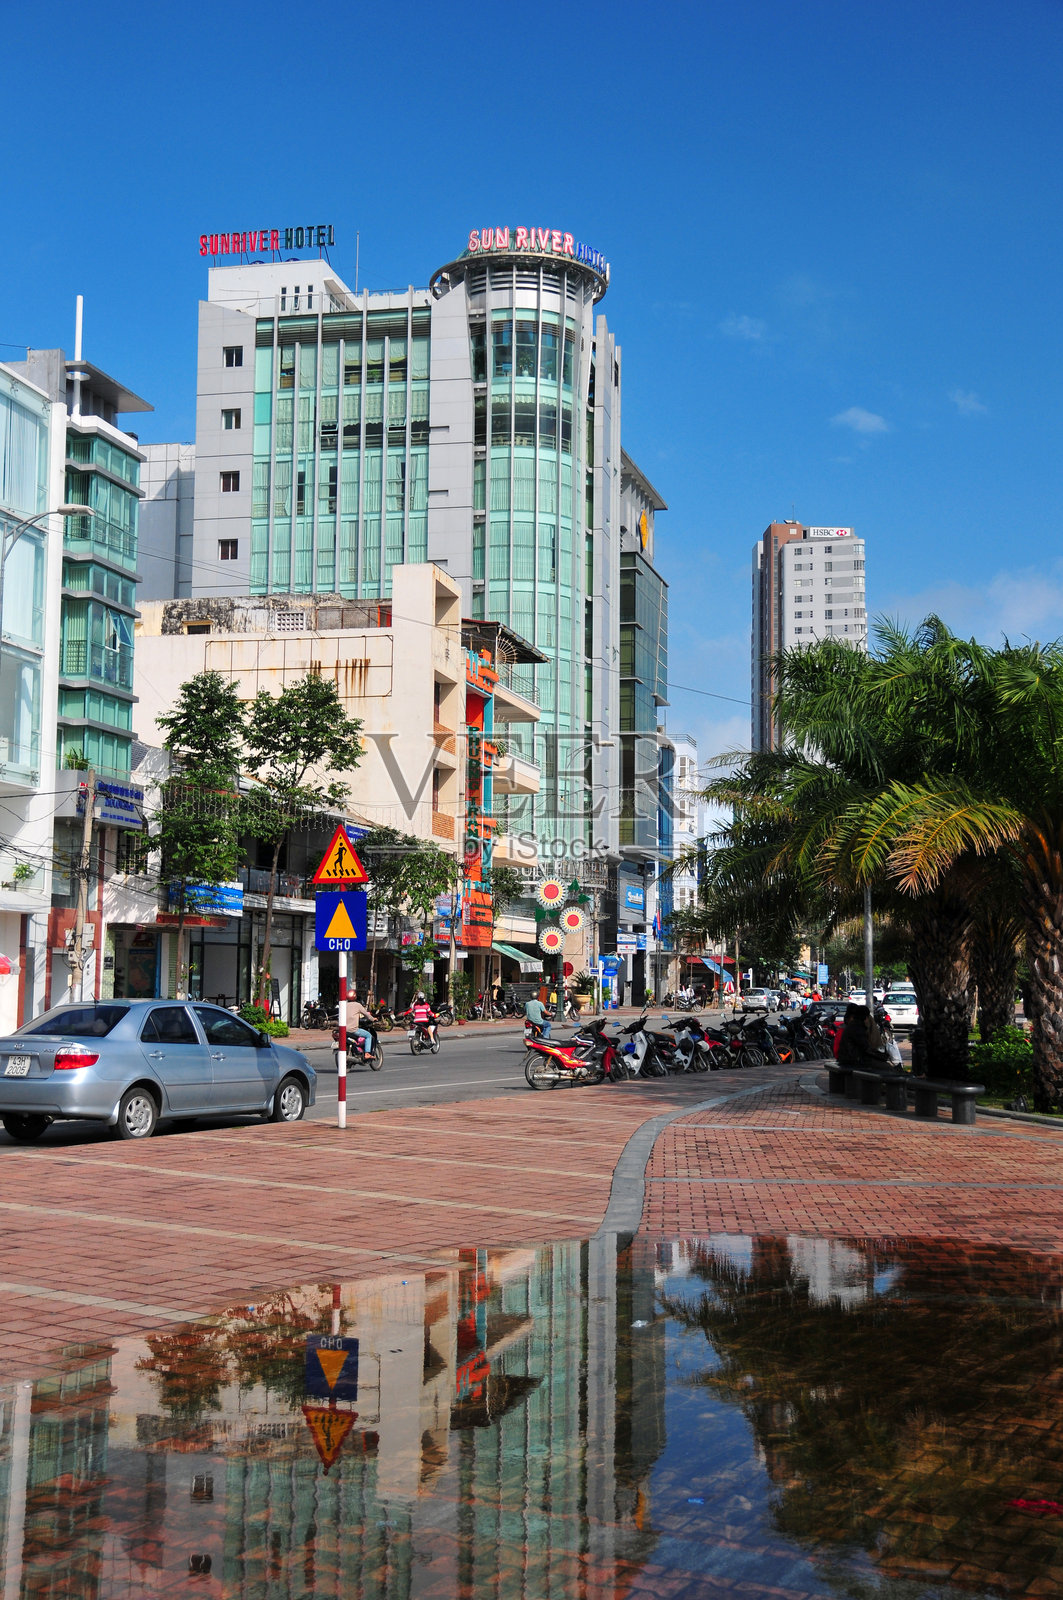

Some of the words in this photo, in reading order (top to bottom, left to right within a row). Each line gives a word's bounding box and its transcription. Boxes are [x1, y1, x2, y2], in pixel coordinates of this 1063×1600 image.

[199, 229, 279, 256] SUNRIVER
[285, 225, 335, 250] HOTEL
[468, 226, 509, 252] SUN
[516, 226, 575, 256] RIVER
[328, 938, 351, 950] CHO
[7, 1066, 26, 1074] 2005
